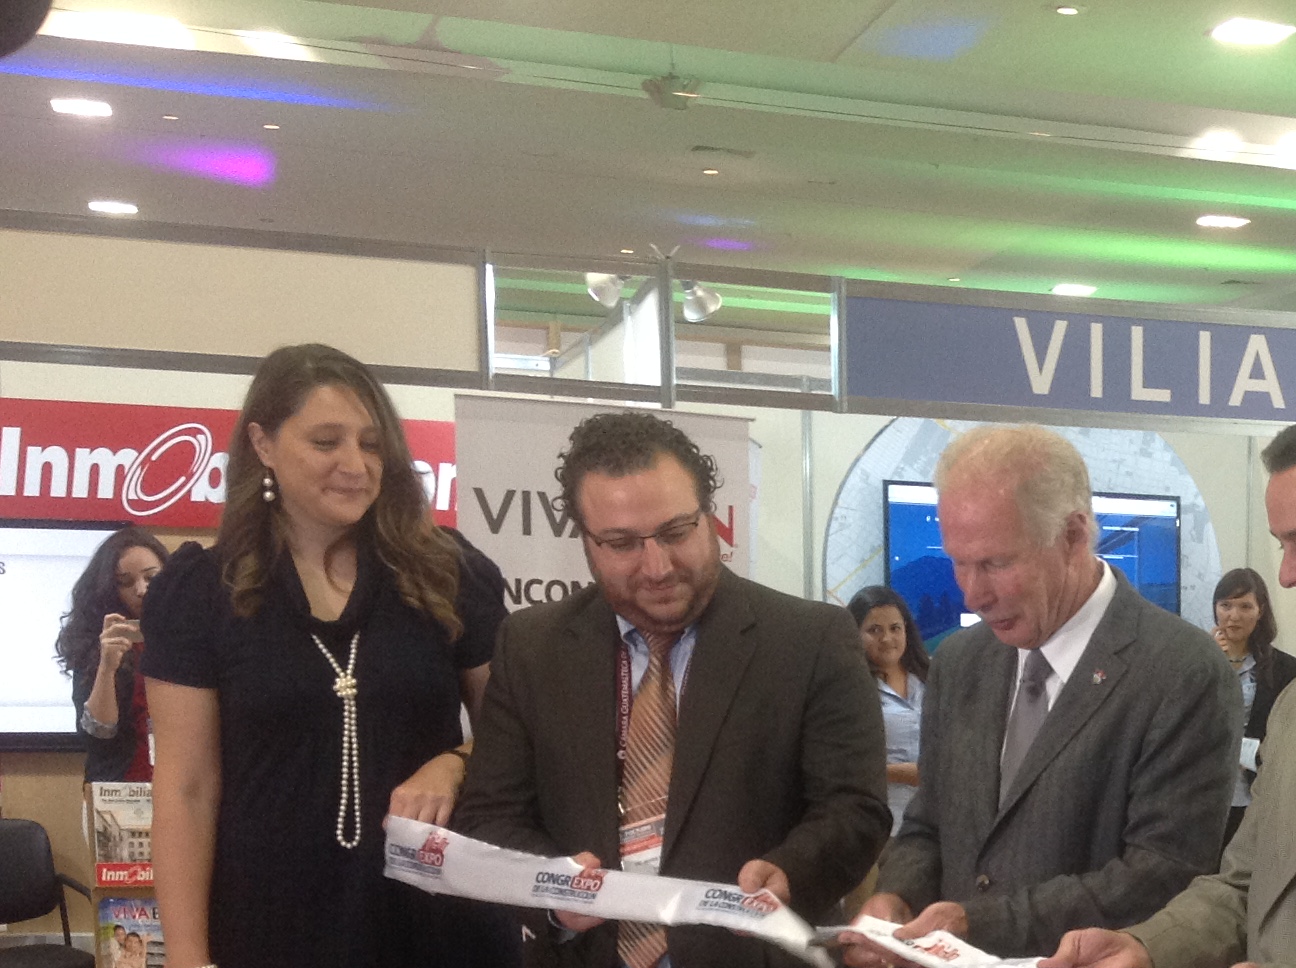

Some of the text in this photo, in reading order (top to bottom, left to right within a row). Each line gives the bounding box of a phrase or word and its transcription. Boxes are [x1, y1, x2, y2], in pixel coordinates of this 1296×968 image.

[1013, 316, 1286, 409] VILIA
[472, 487, 581, 539] VIV
[112, 906, 150, 919] VIVA
